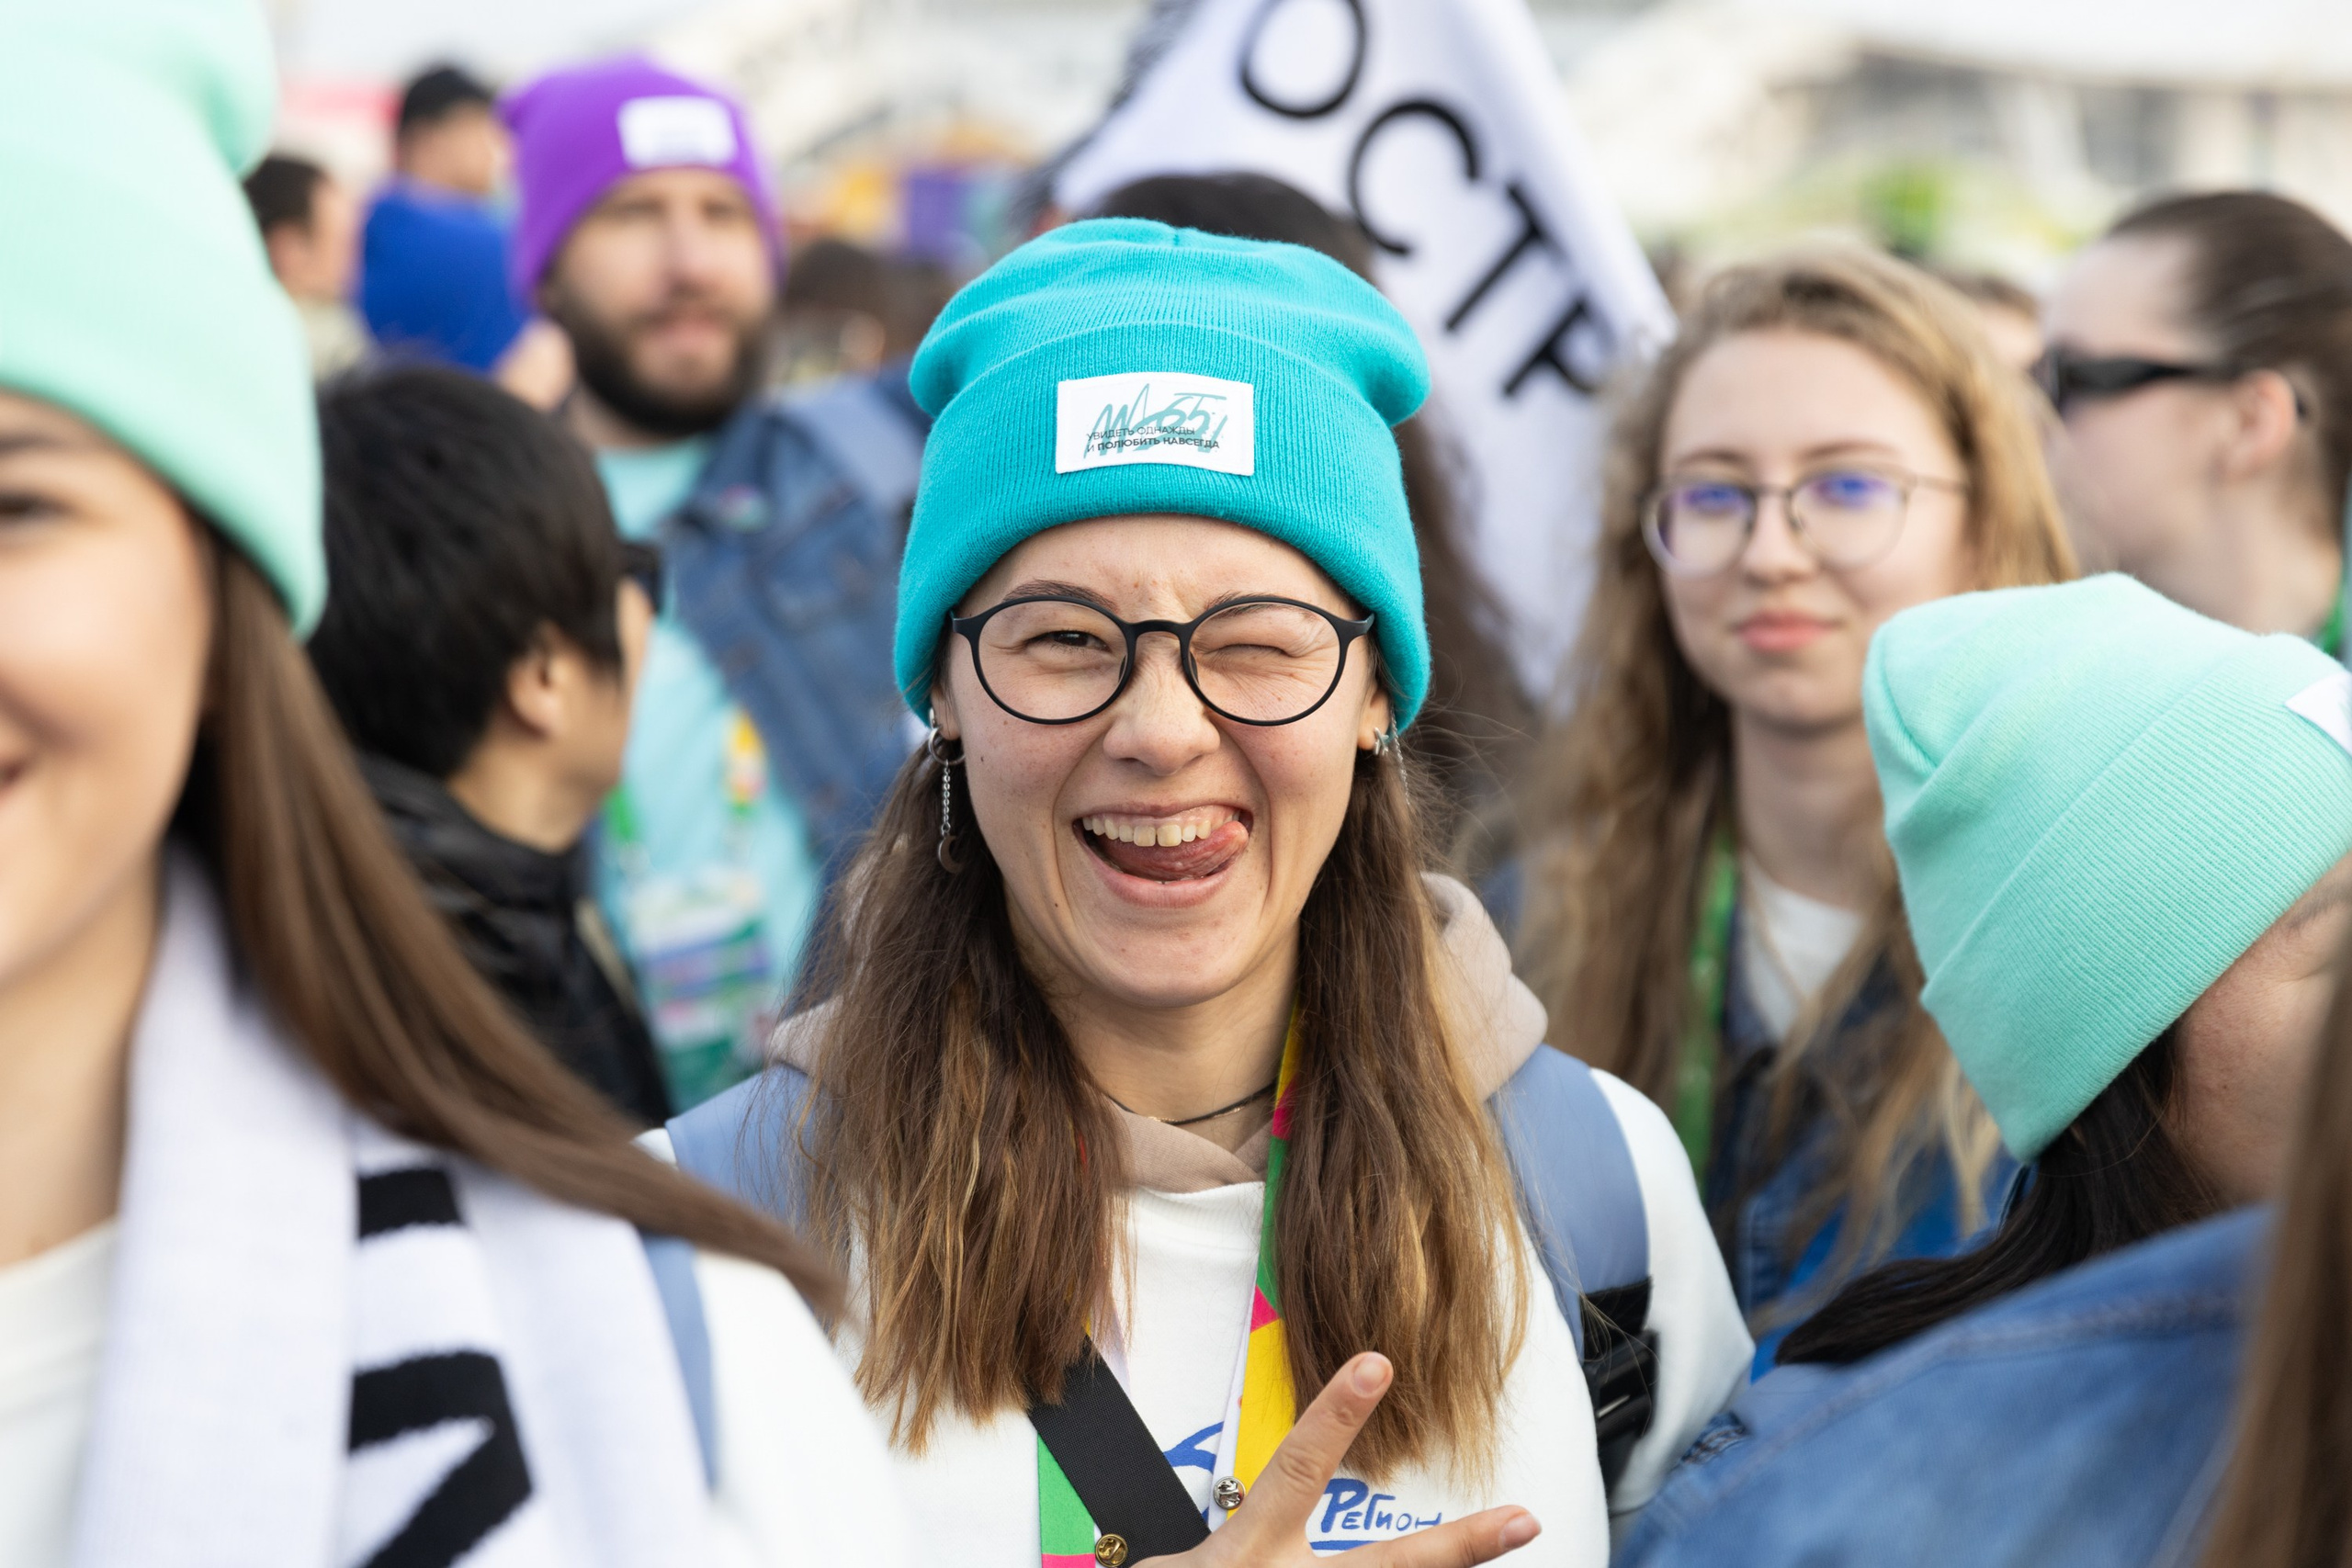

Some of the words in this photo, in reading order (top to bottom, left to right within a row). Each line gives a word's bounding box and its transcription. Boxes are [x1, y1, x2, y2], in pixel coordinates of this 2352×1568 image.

[1087, 426, 1134, 441] УВИДЕТЬ
[1136, 426, 1194, 435] ОДНАЖДЫ
[1087, 444, 1095, 452] И
[1098, 437, 1159, 450] ПОЛЮБИТЬ
[1163, 436, 1219, 448] НАВСЕГДА
